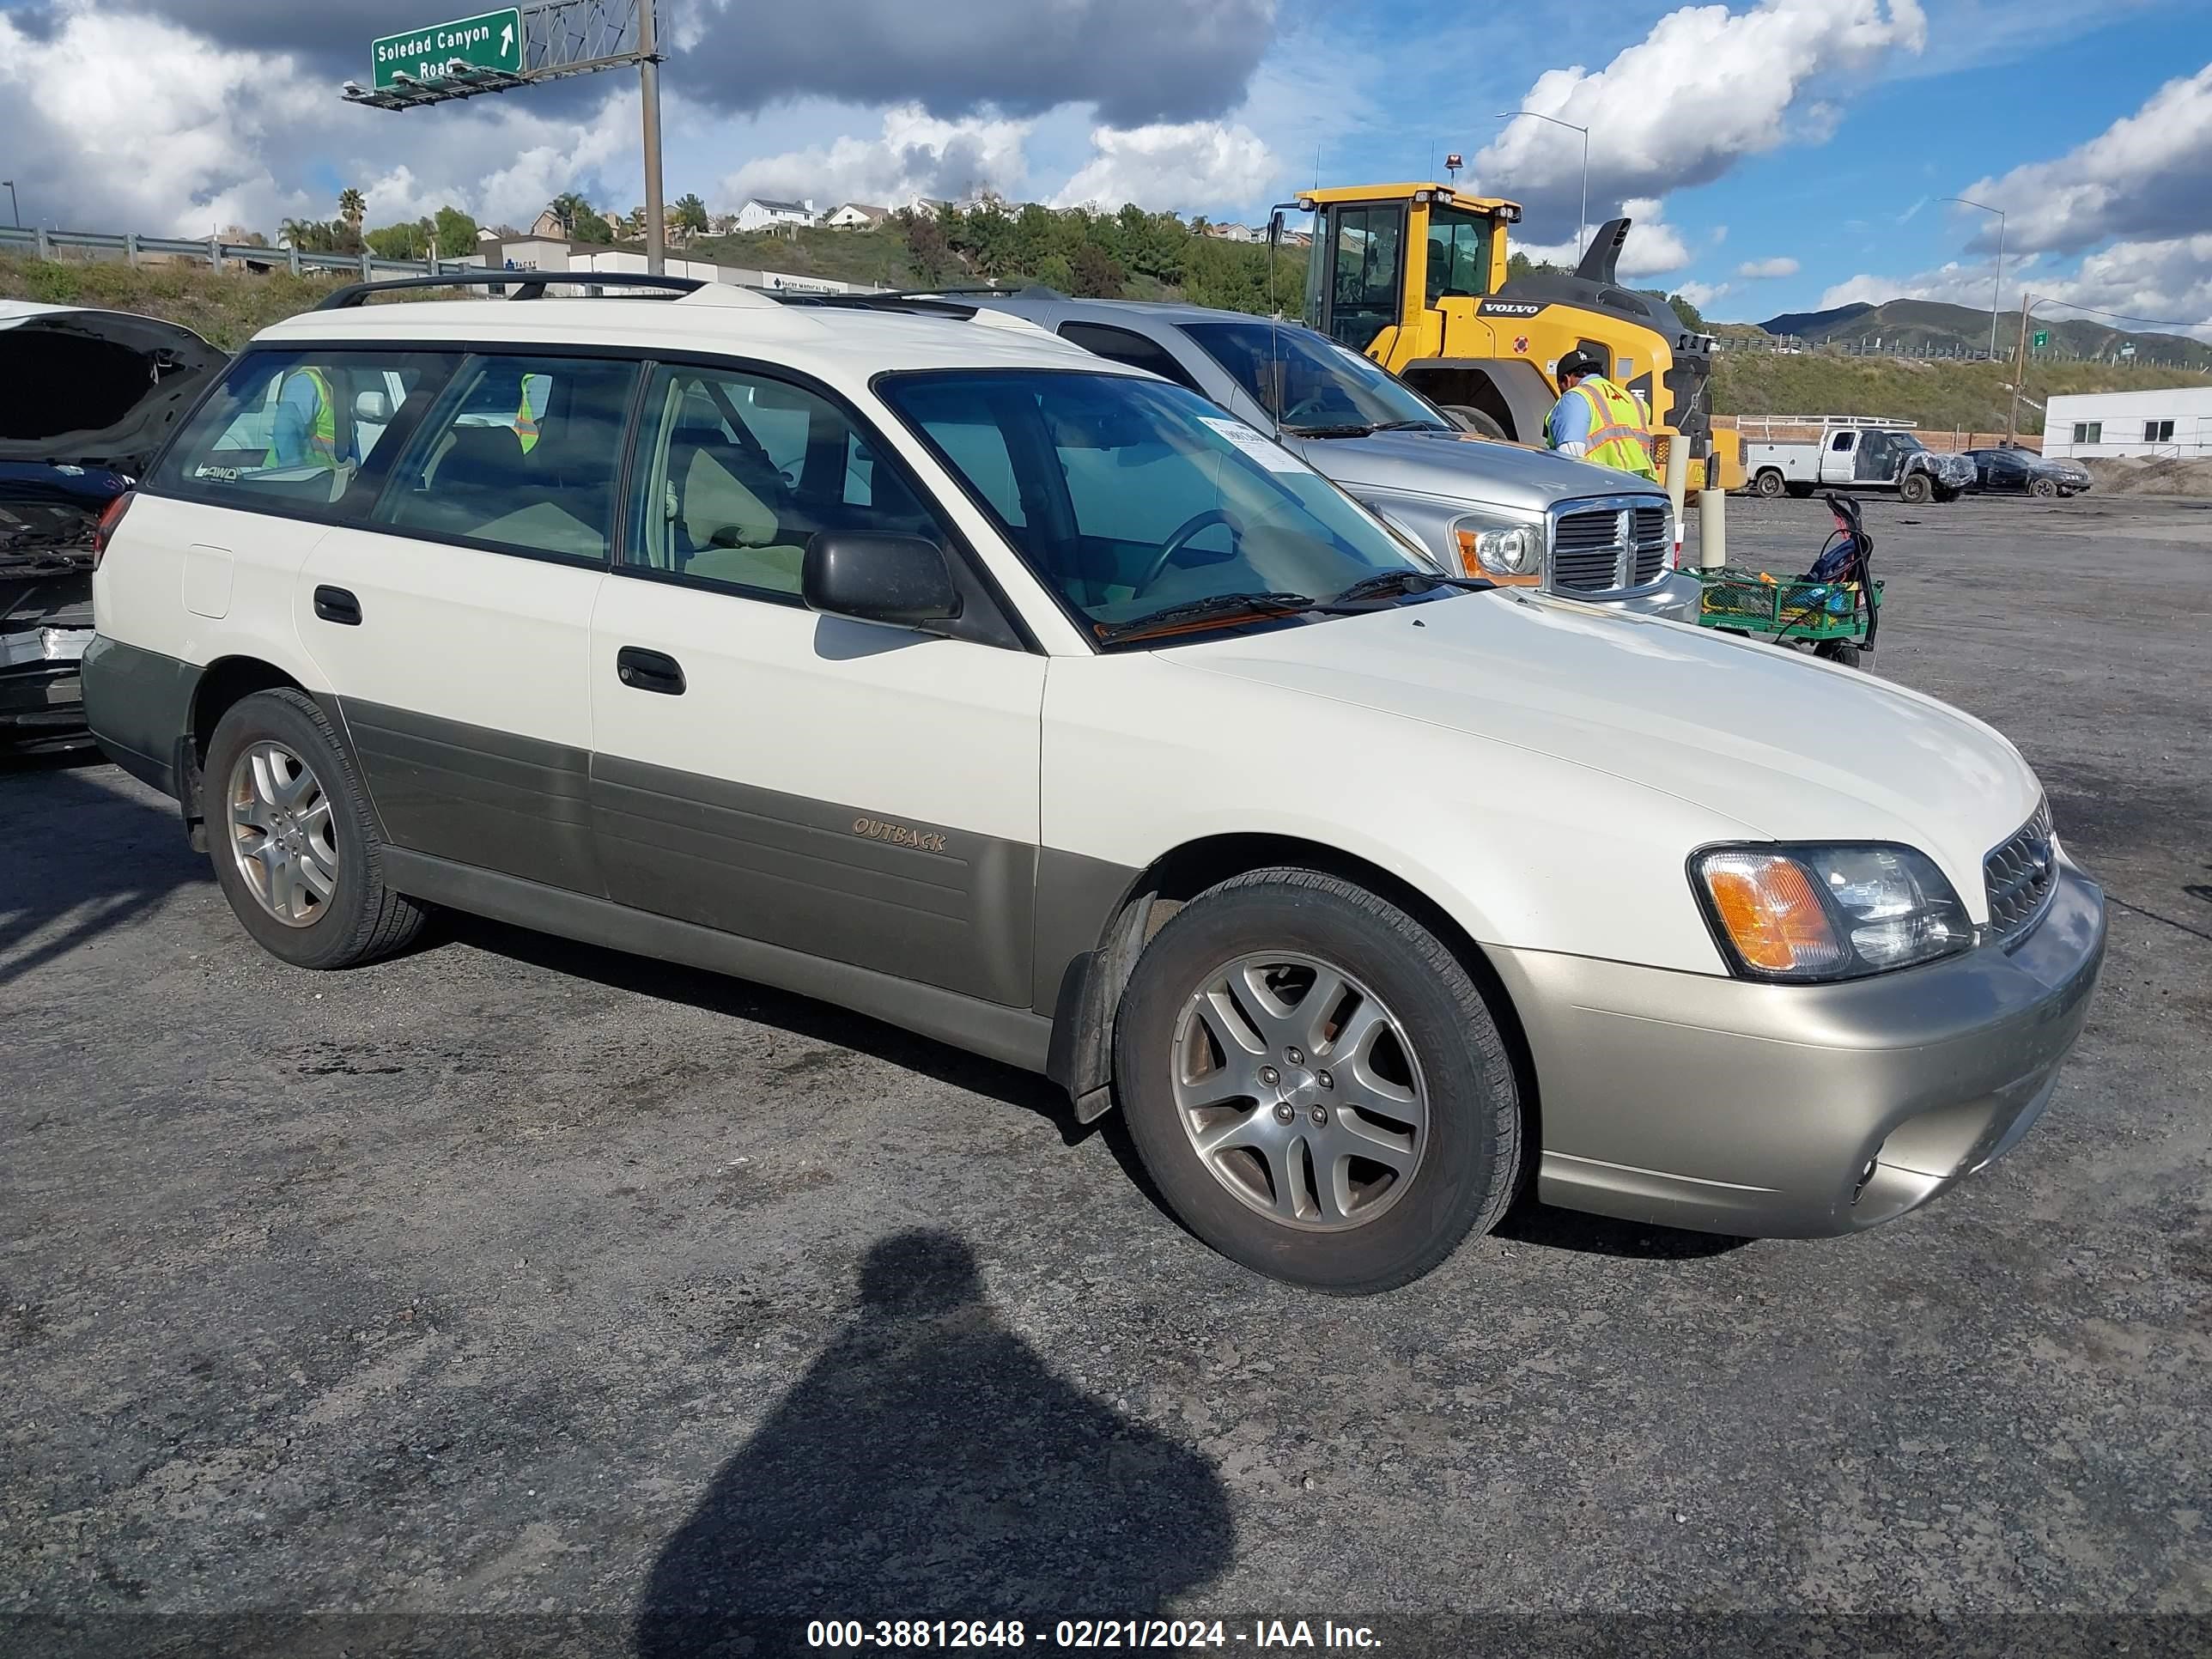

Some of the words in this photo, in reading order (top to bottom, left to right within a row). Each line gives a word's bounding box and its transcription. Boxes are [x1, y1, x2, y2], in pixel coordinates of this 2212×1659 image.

[378, 35, 431, 62] Soledad
[437, 26, 489, 51] Canyon
[1485, 304, 1539, 313] VOLVO
[1577, 350, 1588, 361] LA
[204, 466, 237, 480] AWD
[853, 817, 947, 852] OUTBACK
